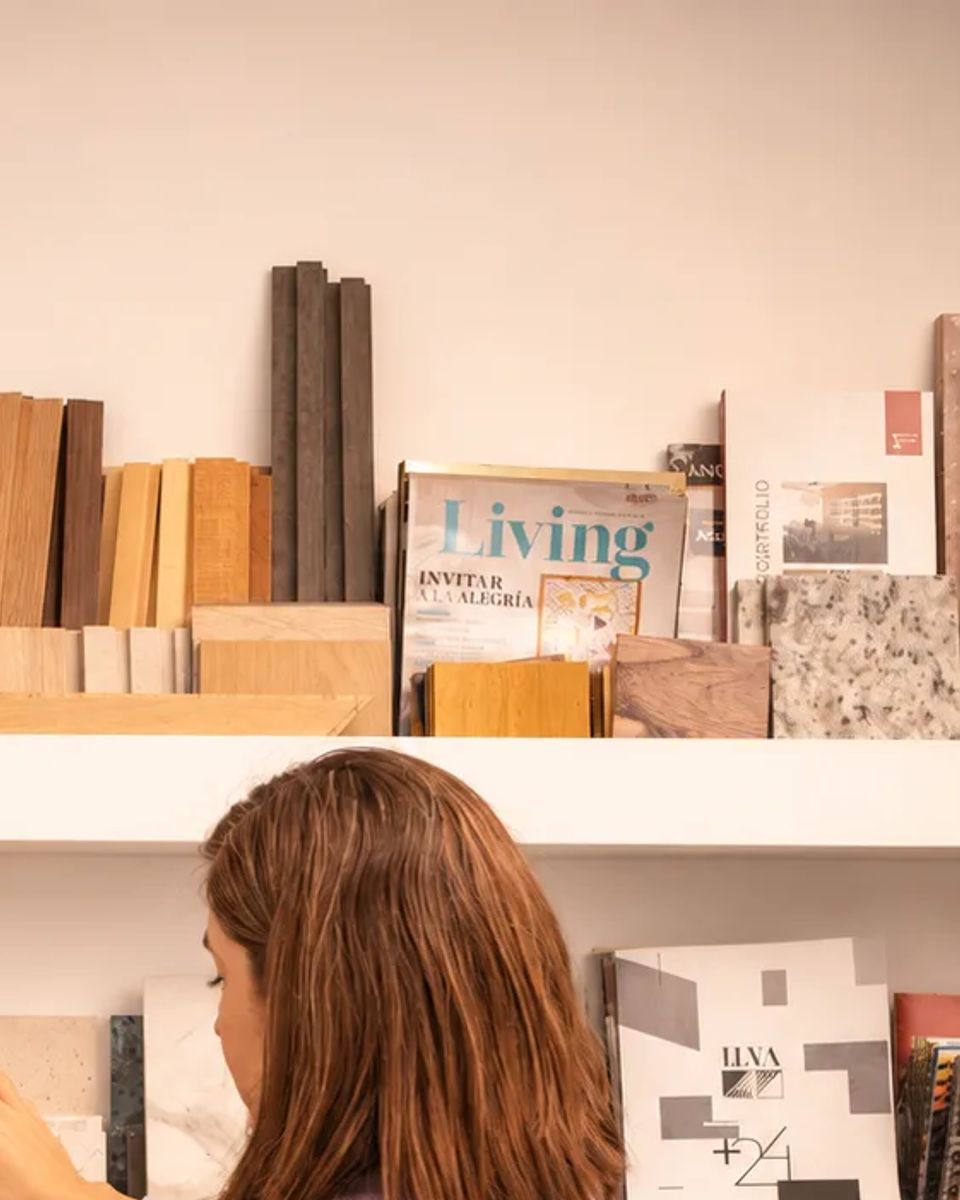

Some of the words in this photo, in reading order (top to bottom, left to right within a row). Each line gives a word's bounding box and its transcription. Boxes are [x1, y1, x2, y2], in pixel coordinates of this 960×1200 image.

[441, 498, 655, 582] Living
[419, 570, 503, 590] INVITAR
[457, 589, 534, 609] ALEGRÍA
